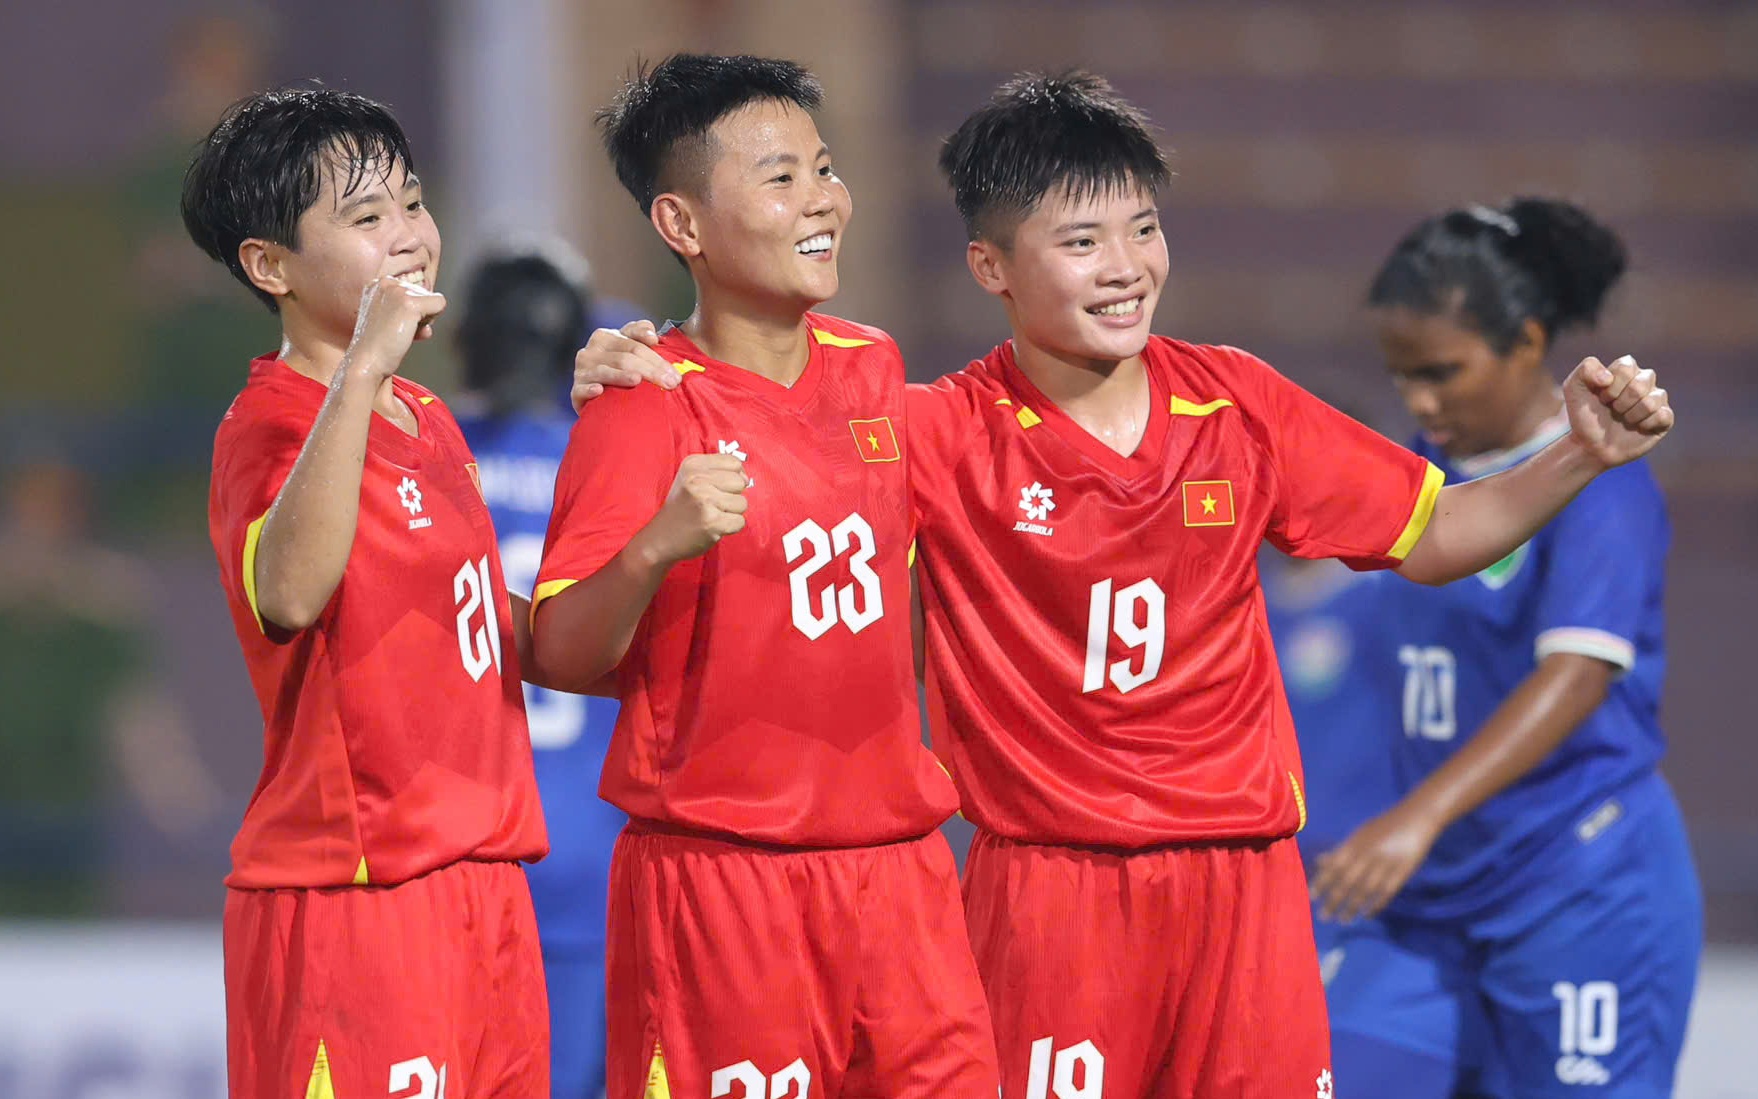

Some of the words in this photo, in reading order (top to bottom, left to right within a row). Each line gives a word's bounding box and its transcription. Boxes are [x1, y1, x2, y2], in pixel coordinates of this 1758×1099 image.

[454, 554, 502, 683] 21
[782, 511, 884, 641] 23
[1082, 577, 1166, 695] 19
[1398, 645, 1457, 740] 10
[1552, 981, 1619, 1056] 10
